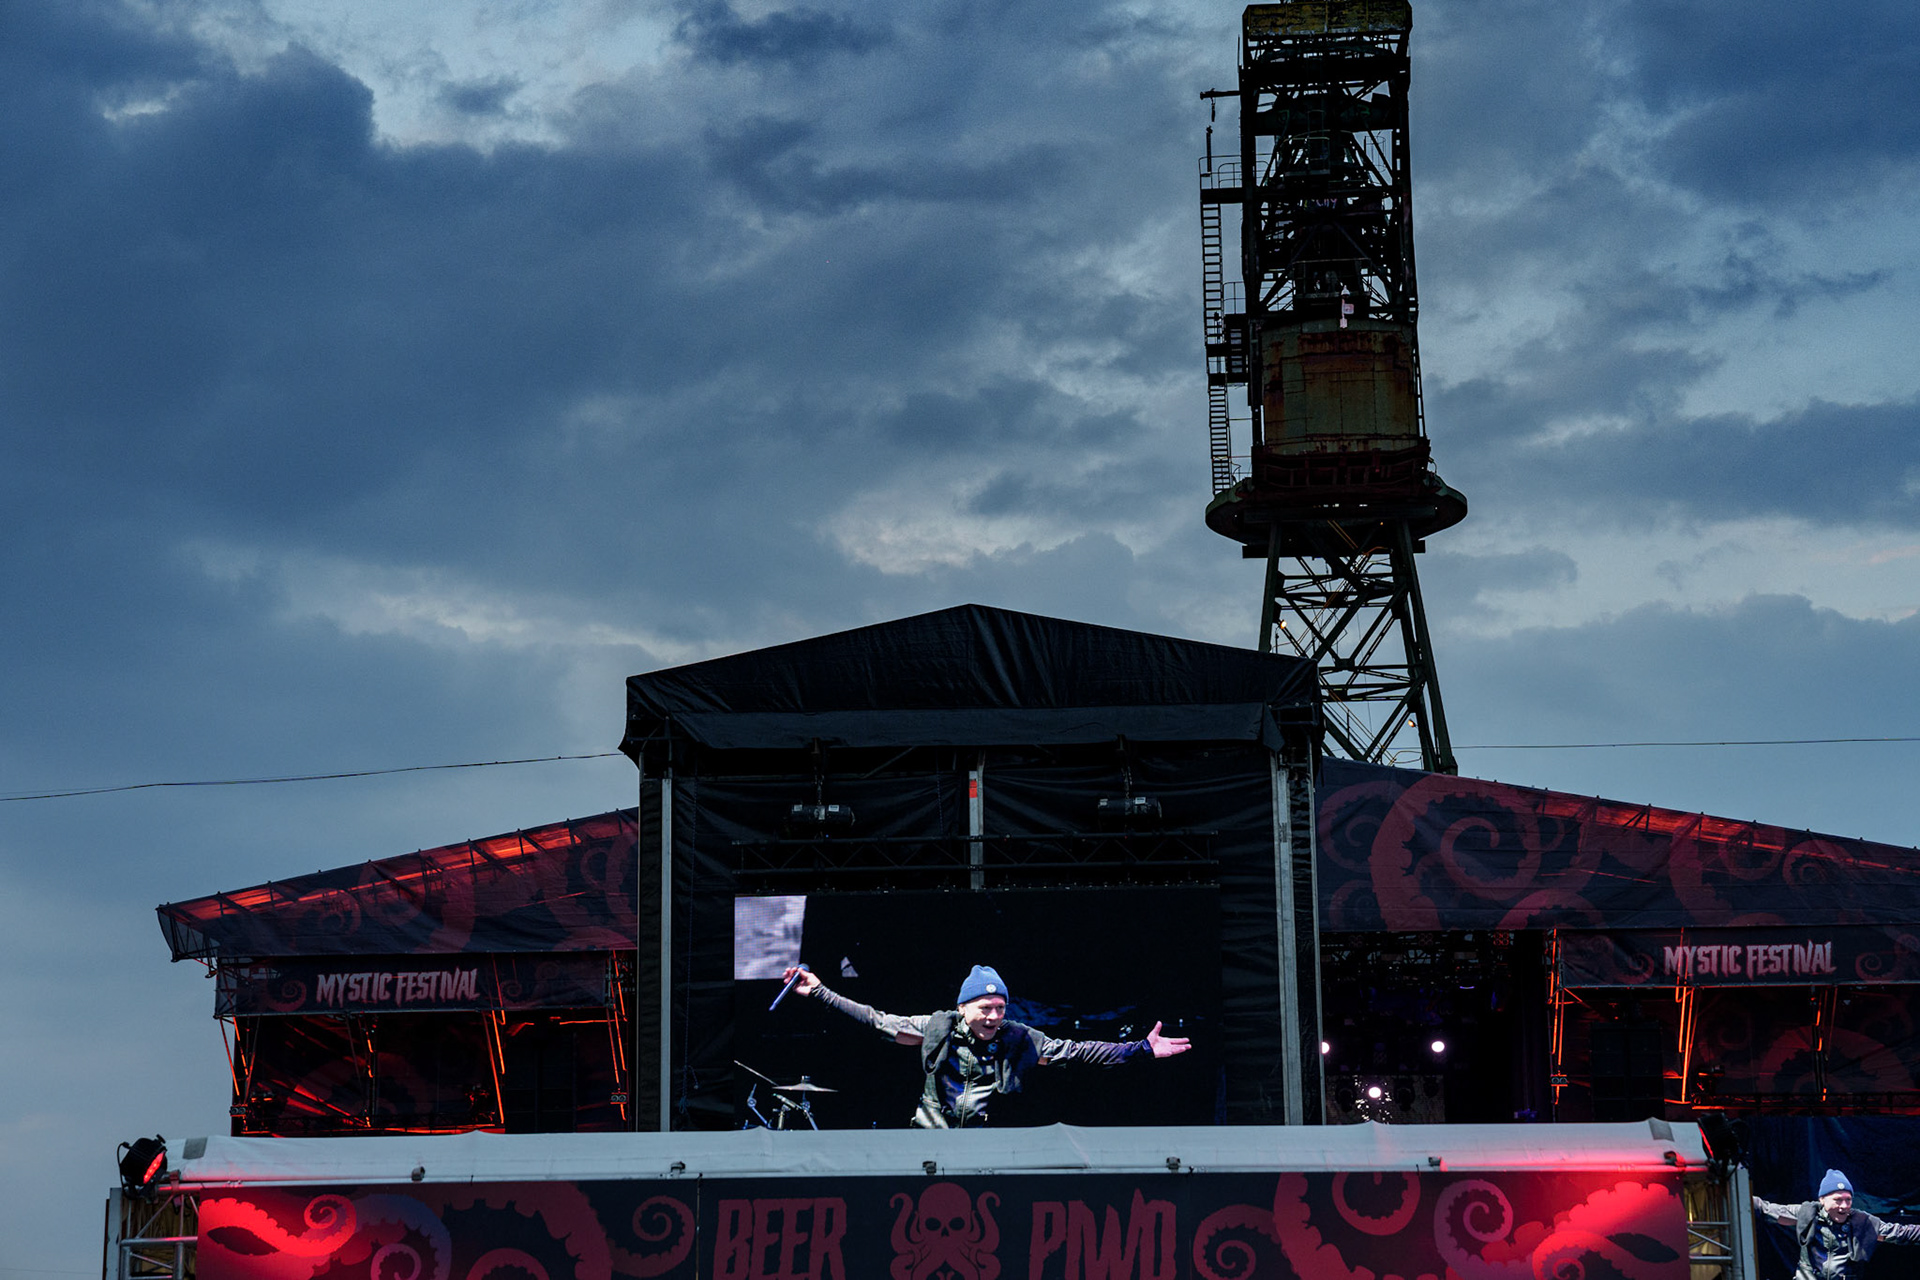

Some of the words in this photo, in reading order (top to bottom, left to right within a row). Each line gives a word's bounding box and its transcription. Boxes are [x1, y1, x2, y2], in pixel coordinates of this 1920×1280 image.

[316, 972, 392, 1008] MYSTIC
[395, 966, 480, 1006] FESTIVAL
[1663, 945, 1742, 980] MYSTIC
[1746, 939, 1837, 981] FESTIVAL
[713, 1197, 847, 1280] BEER
[1029, 1188, 1177, 1280] PIWO
